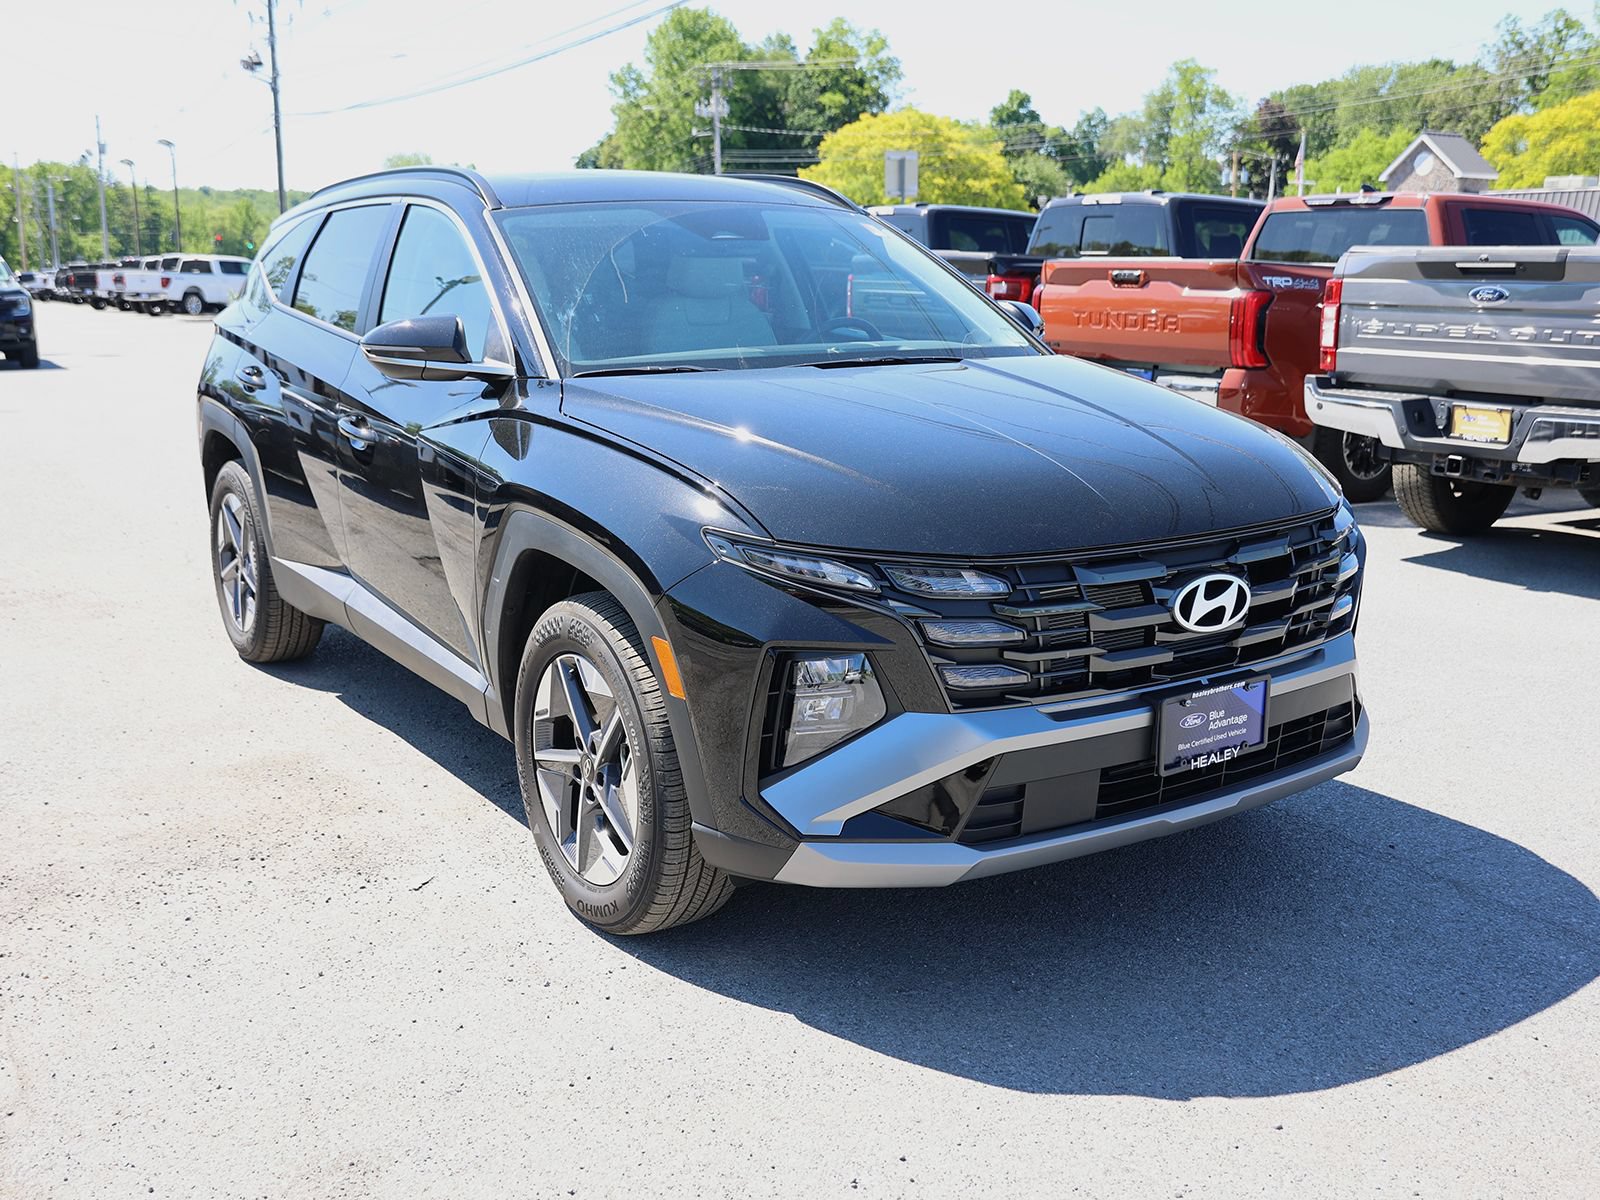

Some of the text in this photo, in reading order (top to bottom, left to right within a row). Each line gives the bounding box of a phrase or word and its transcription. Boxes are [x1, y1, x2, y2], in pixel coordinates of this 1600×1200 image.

[1262, 276, 1293, 288] TRD
[1073, 310, 1182, 333] TUNDRA
[1362, 318, 1499, 339] SUPER
[1192, 681, 1246, 699] healeybrothers.com
[1183, 714, 1204, 727] Ford
[1208, 714, 1248, 731] Advantage
[1209, 709, 1225, 720] Blue
[1178, 728, 1247, 751] Blue Certified Used Vehicle
[1191, 746, 1240, 770] HEALEY
[577, 900, 619, 917] KUMHO
